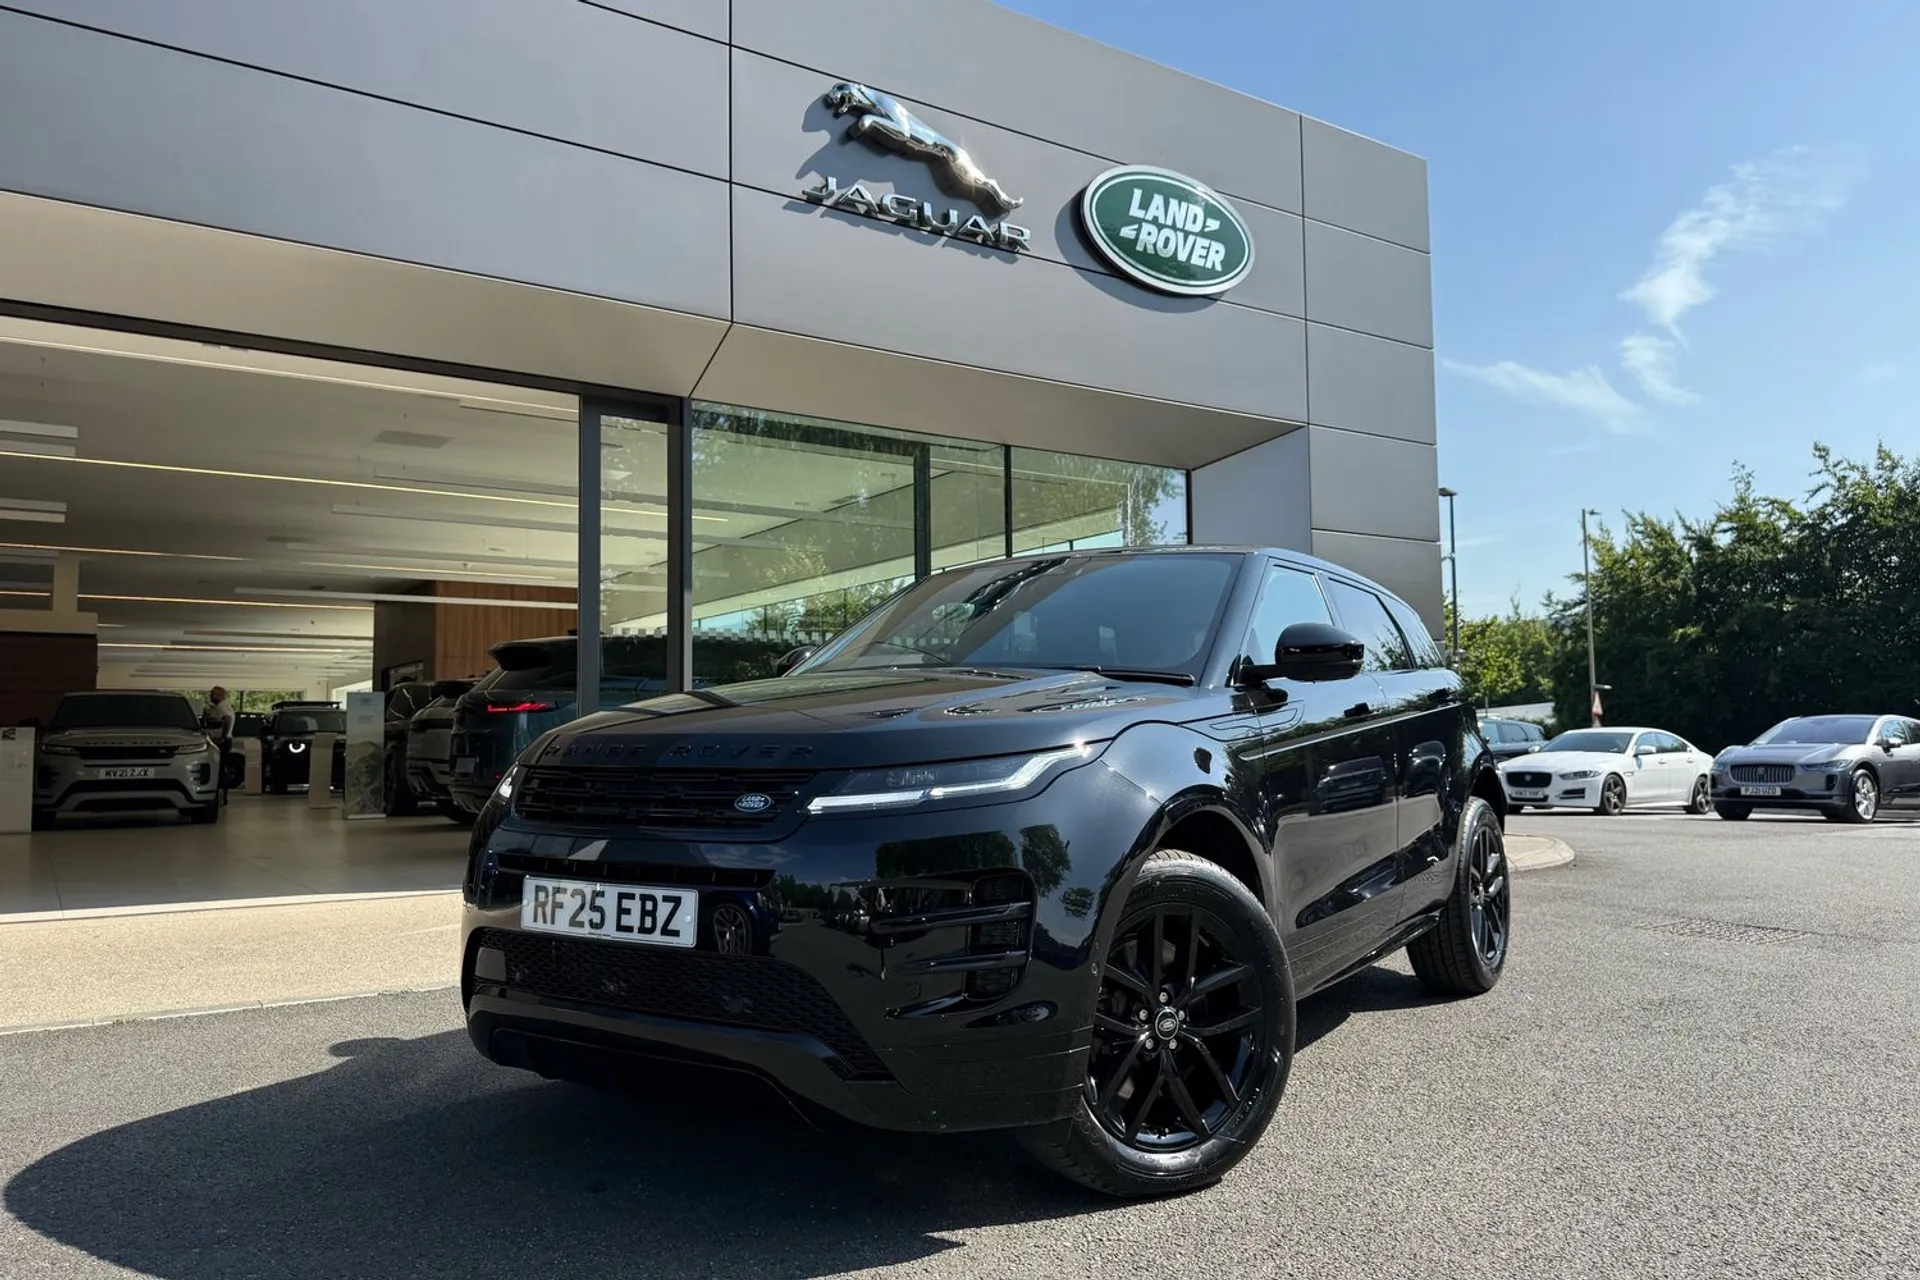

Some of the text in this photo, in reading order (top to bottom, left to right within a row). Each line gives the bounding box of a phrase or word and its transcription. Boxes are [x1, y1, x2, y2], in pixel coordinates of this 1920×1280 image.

[802, 176, 1032, 252] JAGUAR
[1128, 188, 1204, 232] LAND
[1137, 228, 1226, 272] ROVER
[670, 744, 814, 759] ROVER
[533, 885, 682, 937] RF25 EBZ
